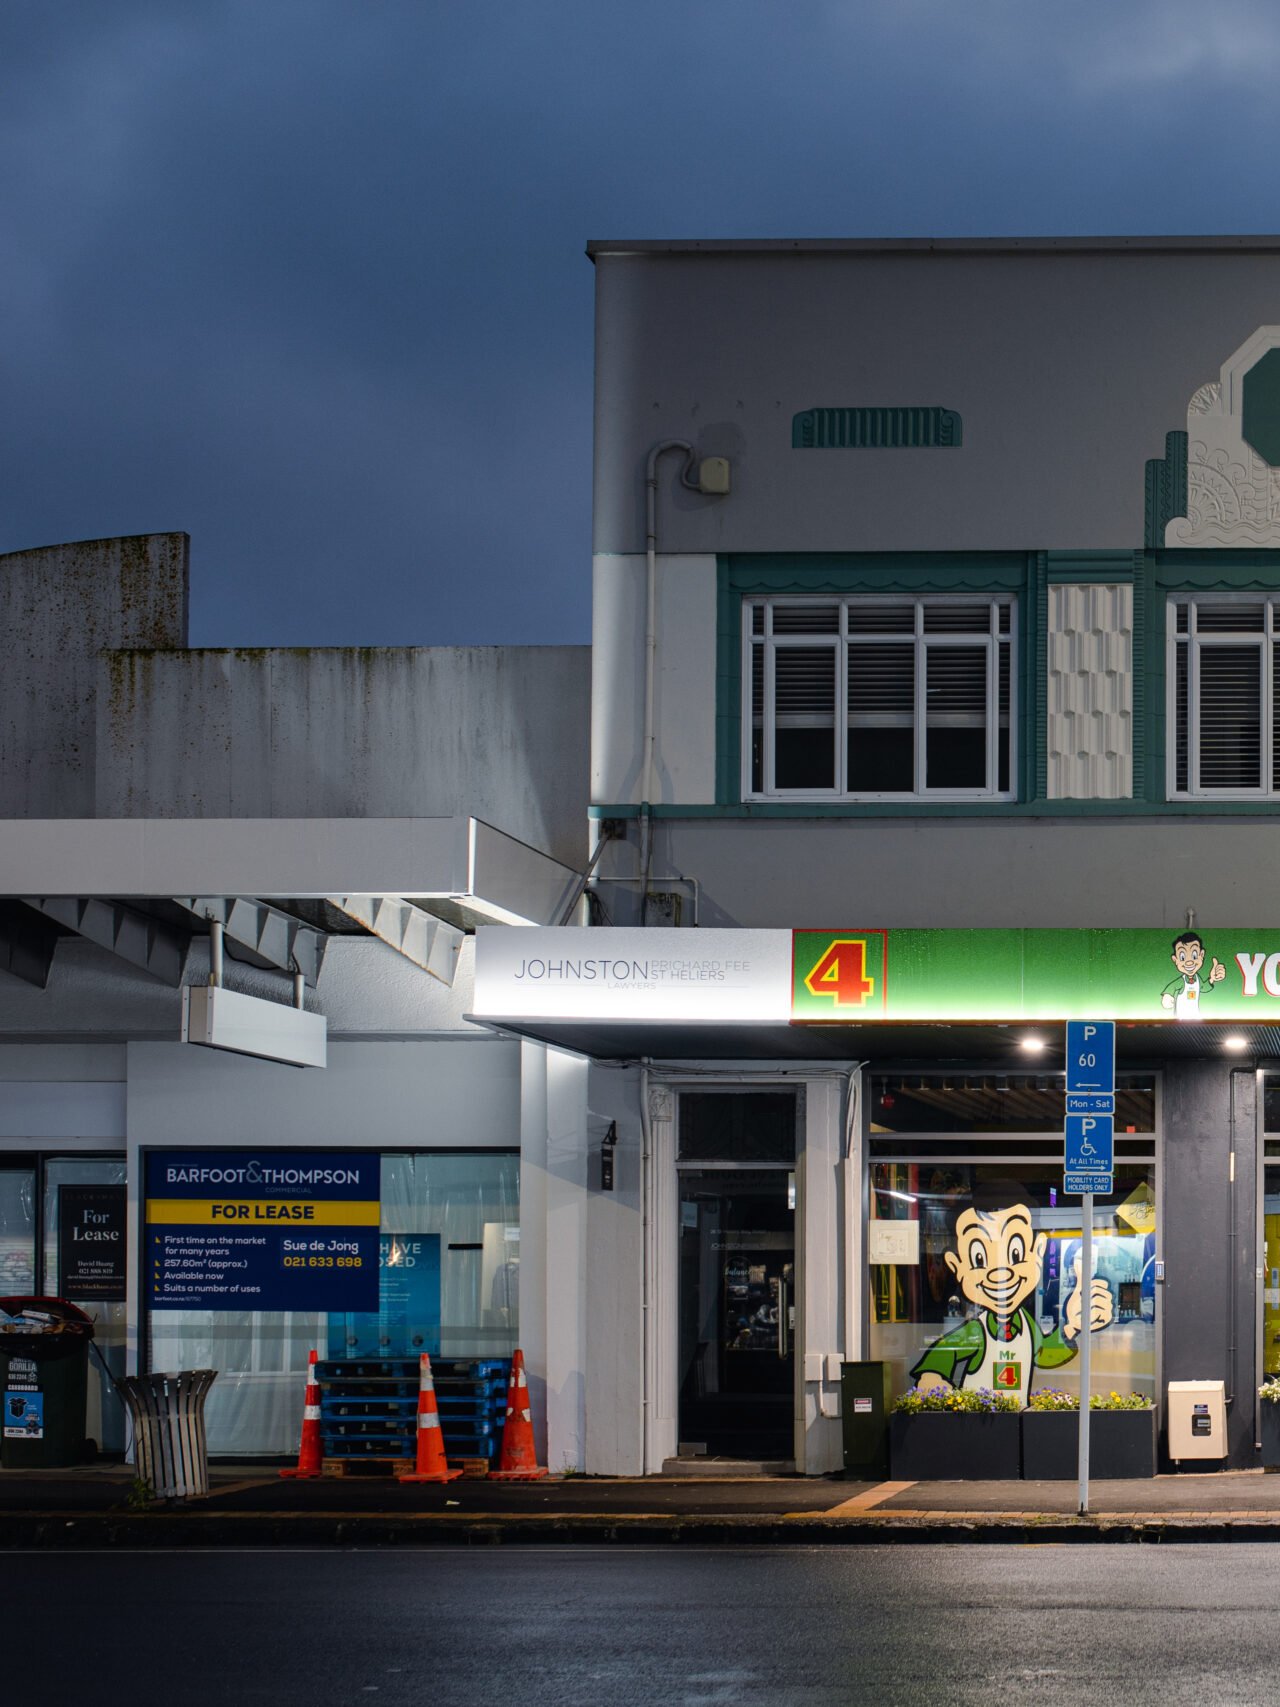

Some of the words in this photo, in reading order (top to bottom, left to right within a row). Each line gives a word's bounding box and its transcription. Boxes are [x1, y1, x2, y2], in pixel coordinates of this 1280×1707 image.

[514, 959, 649, 980] JOHNSTON
[651, 960, 720, 971] PRICHARD
[726, 961, 750, 971] FEE
[651, 970, 664, 980] ST
[671, 970, 725, 981] HELIERS
[804, 940, 874, 1008] 4
[607, 982, 656, 990] LAWYERS
[1084, 1026, 1096, 1040] P
[1079, 1054, 1096, 1067] 60
[1070, 1100, 1088, 1108] Mon
[1096, 1100, 1110, 1108] Sat
[1082, 1118, 1096, 1135] P
[83, 1209, 110, 1224] For
[212, 1205, 250, 1219] FOR
[254, 1206, 314, 1219] LEASE
[73, 1227, 119, 1241] Lease
[164, 1236, 184, 1244] First
[186, 1236, 203, 1244] time
[219, 1236, 233, 1245] the
[235, 1237, 267, 1245] market
[165, 1247, 178, 1255] for
[179, 1248, 203, 1256] many
[283, 1240, 307, 1251] Sue
[309, 1240, 325, 1251] de
[327, 1240, 359, 1254] Jong
[380, 1243, 421, 1254] HAVE
[208, 1260, 248, 1269] (approx.)
[283, 1257, 306, 1267] 021
[309, 1257, 333, 1267] 633
[336, 1257, 362, 1268] 698
[164, 1272, 204, 1280] Available
[164, 1283, 186, 1292] Suits
[195, 1284, 229, 1292] number
[230, 1284, 239, 1292] of
[1000, 1350, 1016, 1360] Mr
[997, 1366, 1018, 1387] 4
